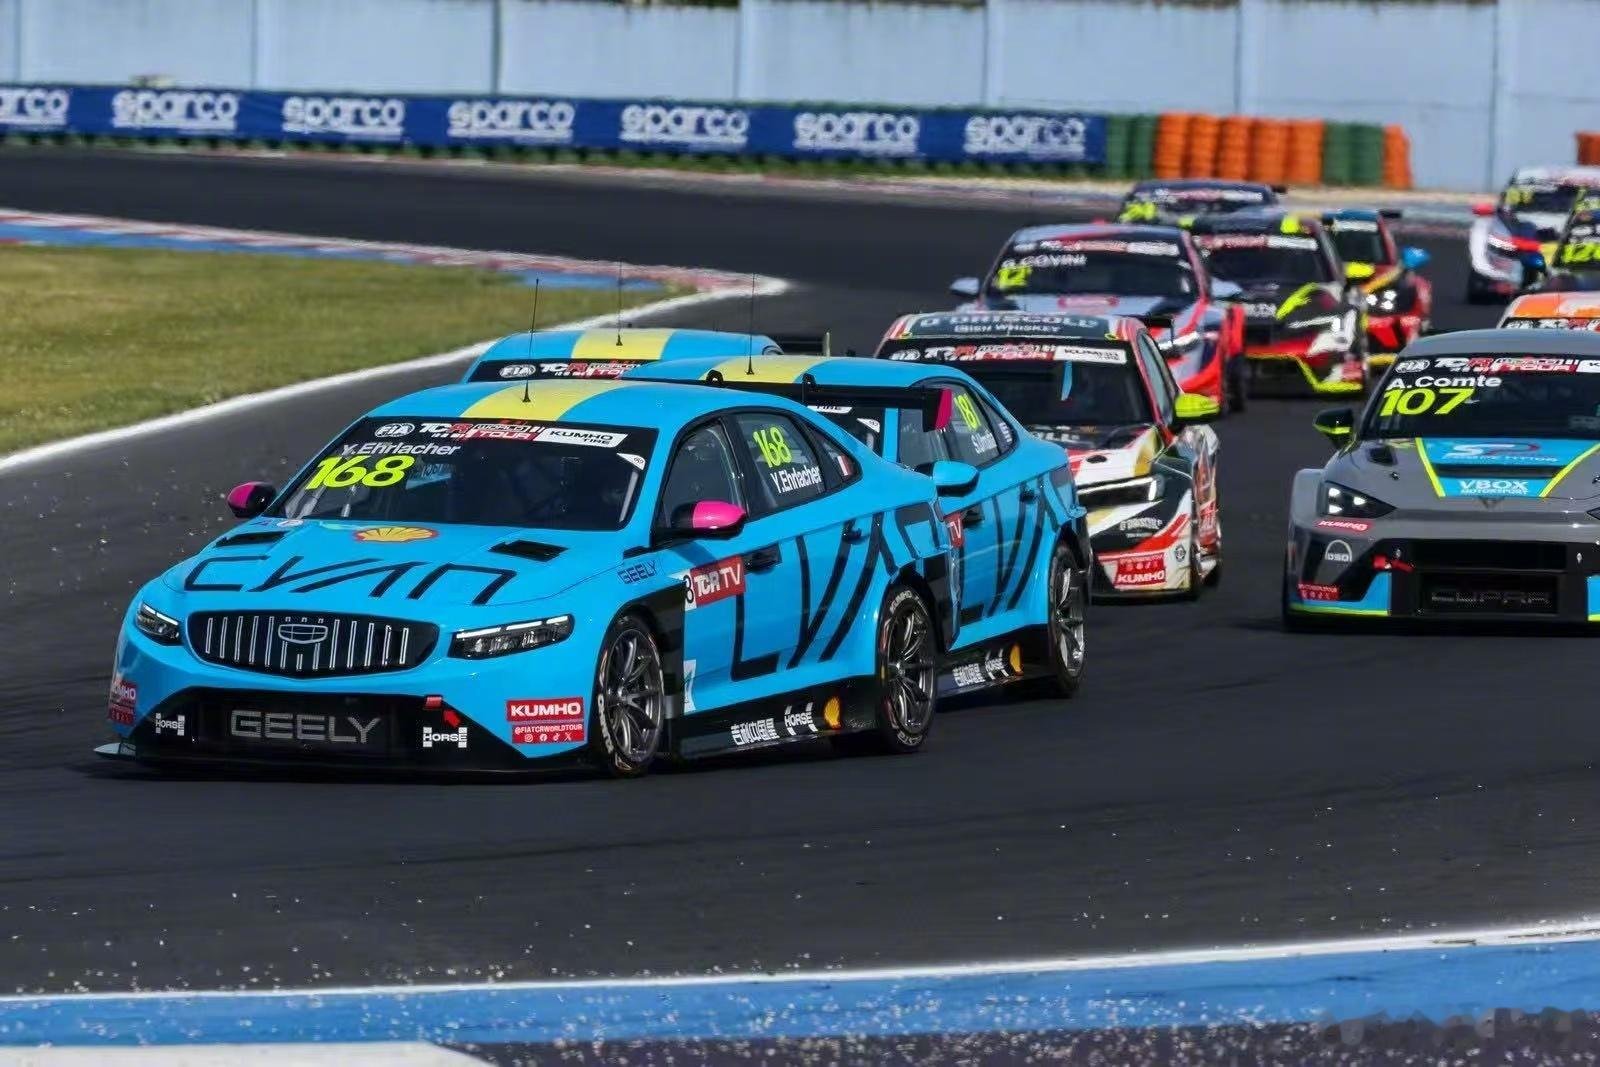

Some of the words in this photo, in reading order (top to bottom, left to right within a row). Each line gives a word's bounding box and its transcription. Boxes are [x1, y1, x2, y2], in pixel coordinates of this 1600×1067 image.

[112, 90, 239, 121] sparco
[282, 96, 405, 126] sparco
[448, 100, 575, 130] sparco
[621, 104, 749, 136] sparco
[794, 111, 920, 144] sparco
[964, 115, 1085, 148] sparco
[1386, 376, 1502, 391] A.Comte
[1380, 388, 1475, 417] 107
[378, 425, 409, 436] FIA
[419, 423, 473, 434] TCR
[479, 431, 534, 440] TOUR
[549, 430, 614, 442] KUMHO
[342, 441, 461, 457] Y.Ehrlacher
[752, 426, 793, 469] 168
[305, 454, 416, 491] 168
[769, 464, 823, 495] Y.Ehrlacher
[1460, 480, 1529, 491] VBOX
[618, 560, 657, 584] GEELY
[693, 570, 721, 597] TCR
[720, 563, 741, 588] TV
[1117, 569, 1165, 584] KUMHO
[511, 702, 581, 717] KUMHO
[784, 710, 814, 727] HORSE
[155, 716, 185, 732] HORSE
[230, 709, 379, 744] GEELY
[515, 724, 583, 734] @FIATCRWORLDTOUR
[422, 731, 468, 744] HORSE
